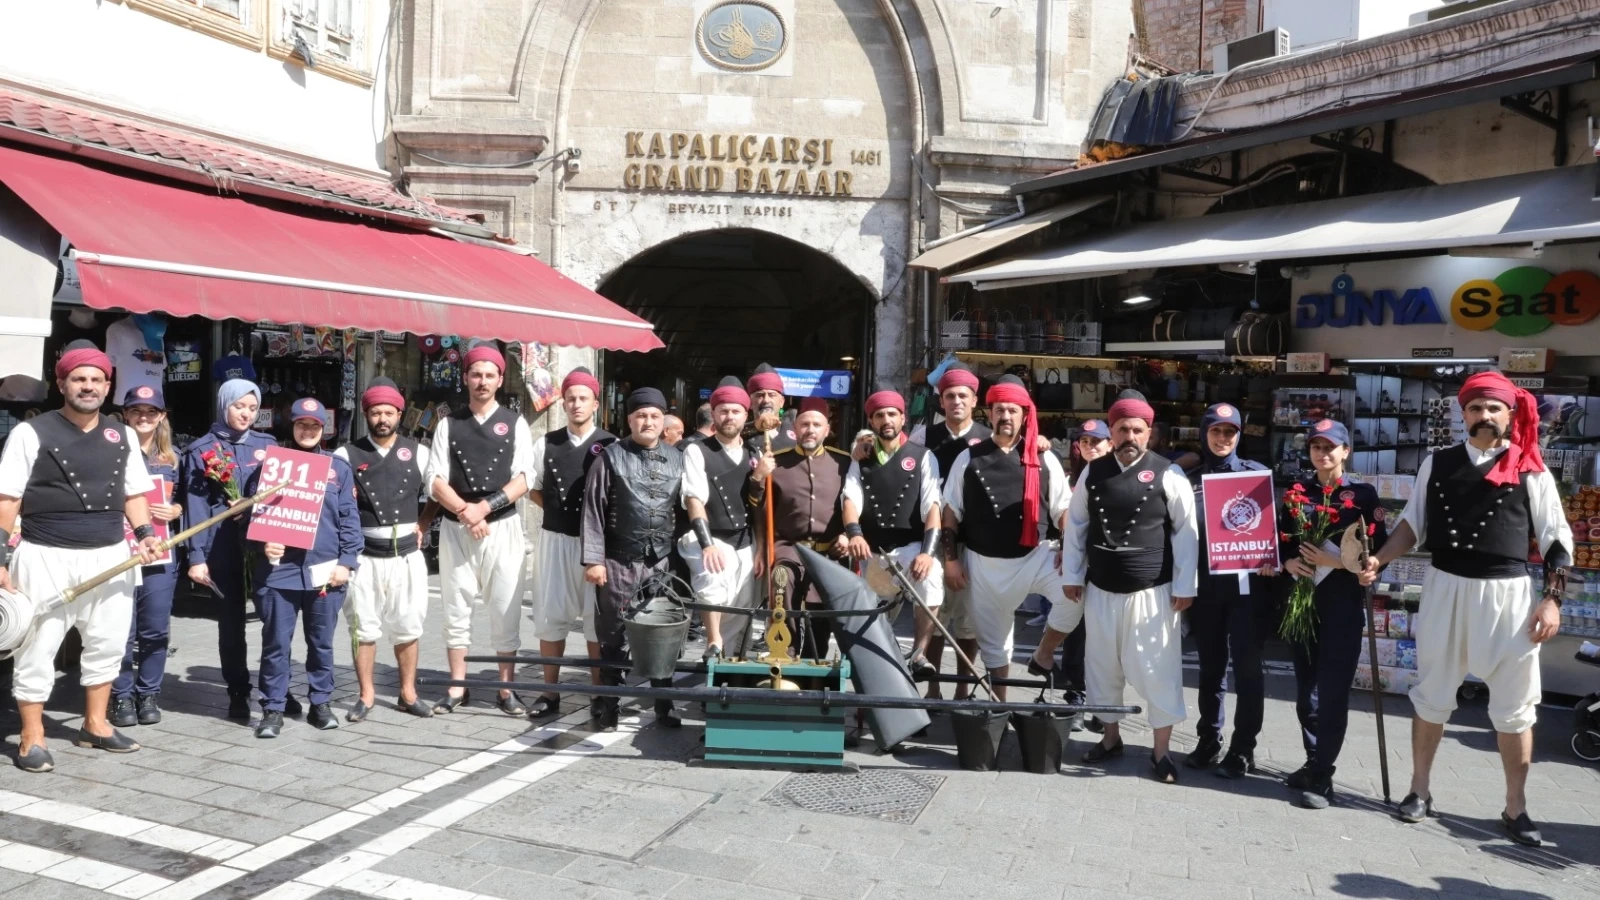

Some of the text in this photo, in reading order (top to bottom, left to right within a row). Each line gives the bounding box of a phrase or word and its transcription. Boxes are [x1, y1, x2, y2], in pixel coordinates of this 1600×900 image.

[625, 131, 833, 170] KAPALIÇARŞI
[850, 150, 882, 166] 1461
[623, 163, 854, 196] GRAND BAZAAR
[668, 203, 793, 218] BEYAZIT KAPISI
[1459, 284, 1580, 318] Saat
[263, 457, 326, 491] 311 th
[252, 503, 318, 524] ISTANBUL
[267, 519, 317, 533] DEPARTMENT
[1211, 540, 1274, 552] ISTANBUL
[1228, 553, 1274, 561] DEPARTMENT
